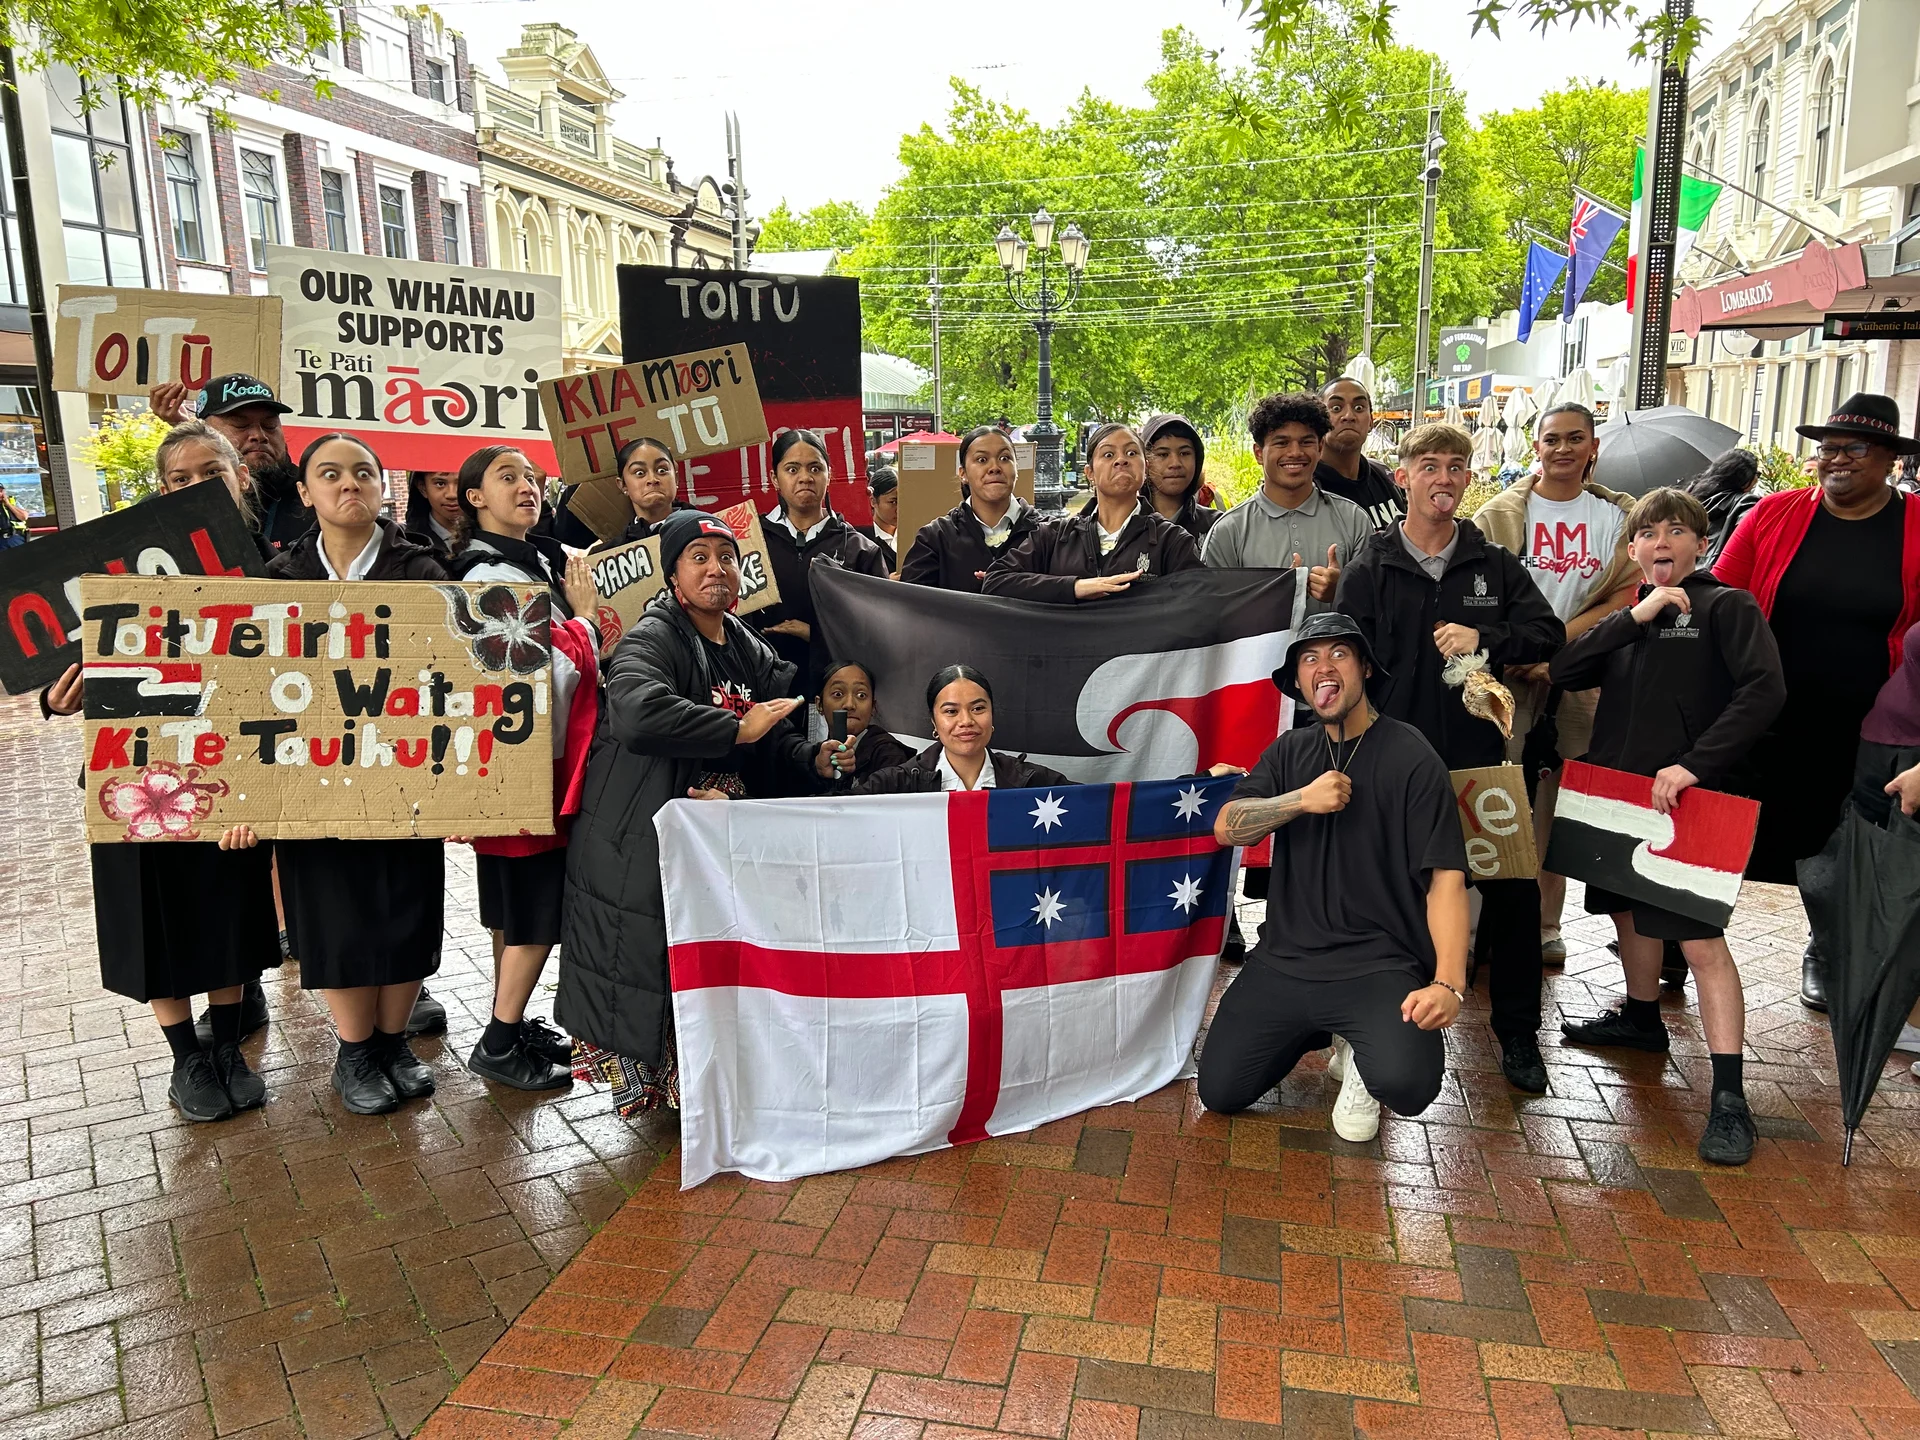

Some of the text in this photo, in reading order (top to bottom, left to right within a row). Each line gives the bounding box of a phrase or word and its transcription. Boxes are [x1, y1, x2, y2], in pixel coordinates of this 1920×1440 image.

[300, 269, 535, 322] OUR WHĀNAU
[1720, 280, 1773, 313] LOMBARDI'S
[338, 311, 504, 356] SUPPORTS
[1442, 332, 1486, 347] HOP FEDERATION
[1671, 341, 1684, 351] VIC
[1856, 321, 1900, 331] Authentic
[294, 349, 373, 373] Te Pāti
[1452, 364, 1473, 373] ON TAP
[295, 366, 545, 432] māori
[554, 368, 645, 424] KIA
[566, 416, 637, 474] TE
[1369, 499, 1404, 528] INA
[1533, 522, 1586, 559] AM
[592, 545, 654, 598] MANA
[1518, 557, 1538, 568] THE
[84, 602, 391, 658] Toitu Te Tiriti
[333, 668, 548, 745] Waitangi
[89, 726, 148, 771] Ki
[160, 718, 227, 766] Te
